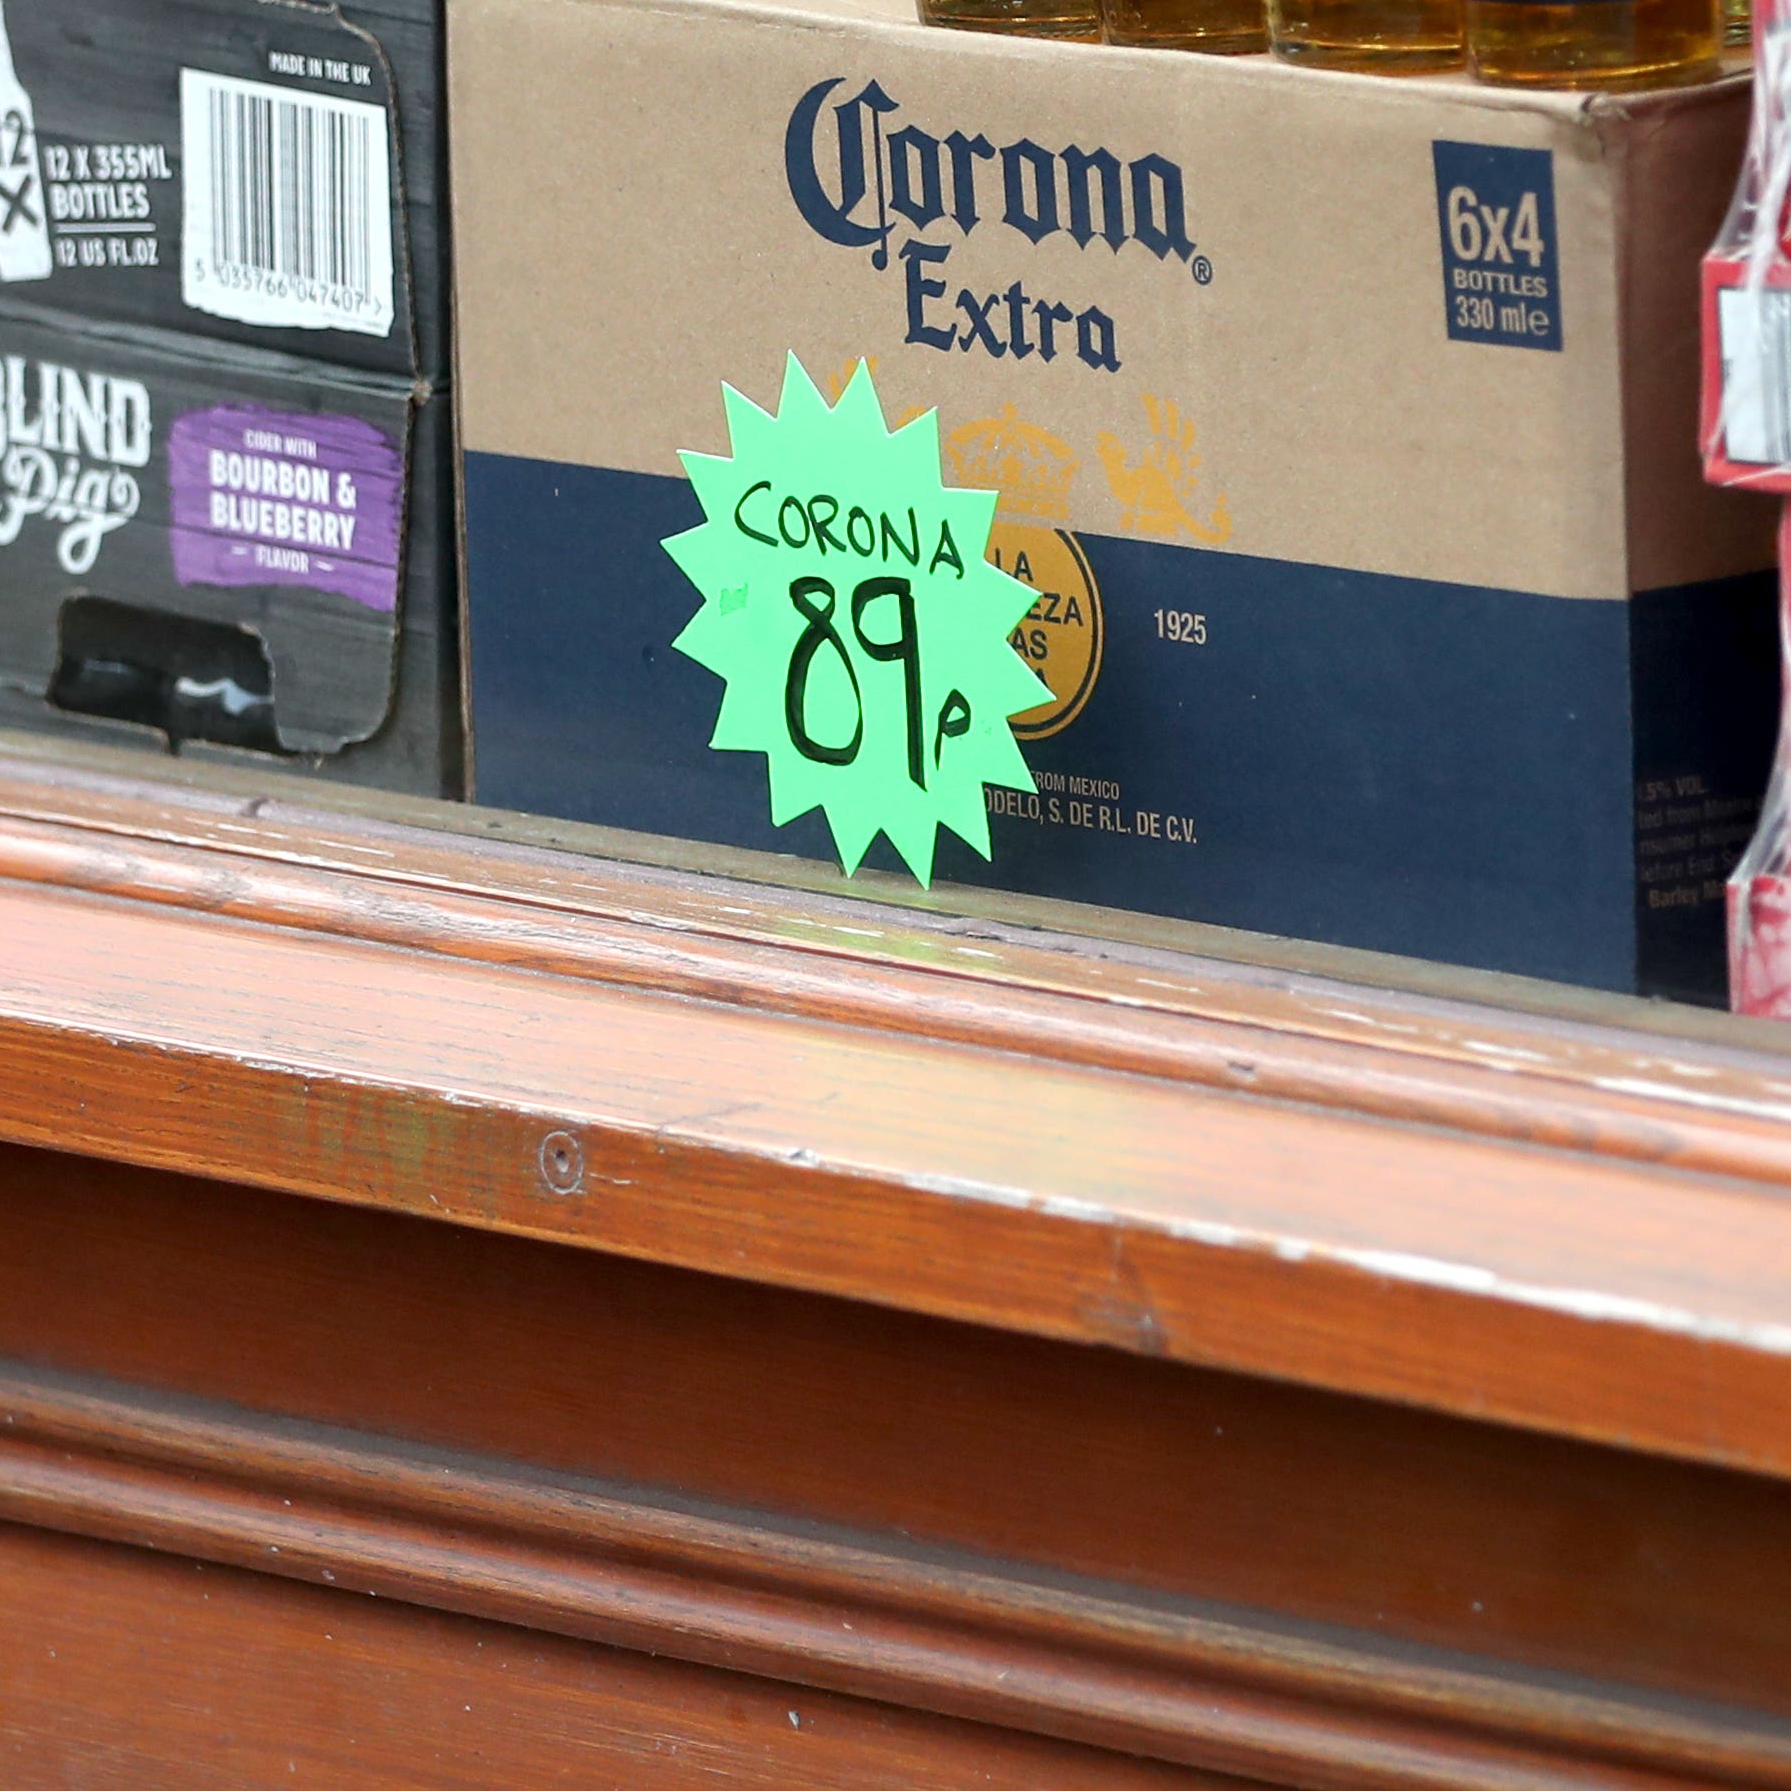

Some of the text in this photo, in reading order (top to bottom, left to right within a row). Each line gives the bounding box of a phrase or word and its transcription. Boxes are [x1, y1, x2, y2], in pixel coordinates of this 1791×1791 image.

[268, 51, 372, 86] MADE IN THE UK
[45, 144, 173, 182] 12 X 355ML
[785, 76, 1199, 271] Corona
[50, 182, 151, 221] BOTTLES
[1446, 185, 1545, 268] 6x4
[57, 239, 78, 265] 12
[80, 239, 107, 265] US
[1452, 267, 1549, 300] BOTTLES
[898, 238, 1123, 374] Extra
[1455, 294, 1495, 332] 330
[243, 428, 318, 461] CIDER WITH
[210, 449, 358, 510] BOURBON &
[210, 493, 356, 552] BLUEBERRY
[732, 478, 966, 582] CORONA
[254, 544, 311, 574] FLAVOR
[1153, 608, 1208, 646] 1925
[783, 574, 973, 794] 89p
[1068, 775, 1121, 801] MEXICO
[1048, 798, 1199, 845] S. DE R.L. DE C.V.
